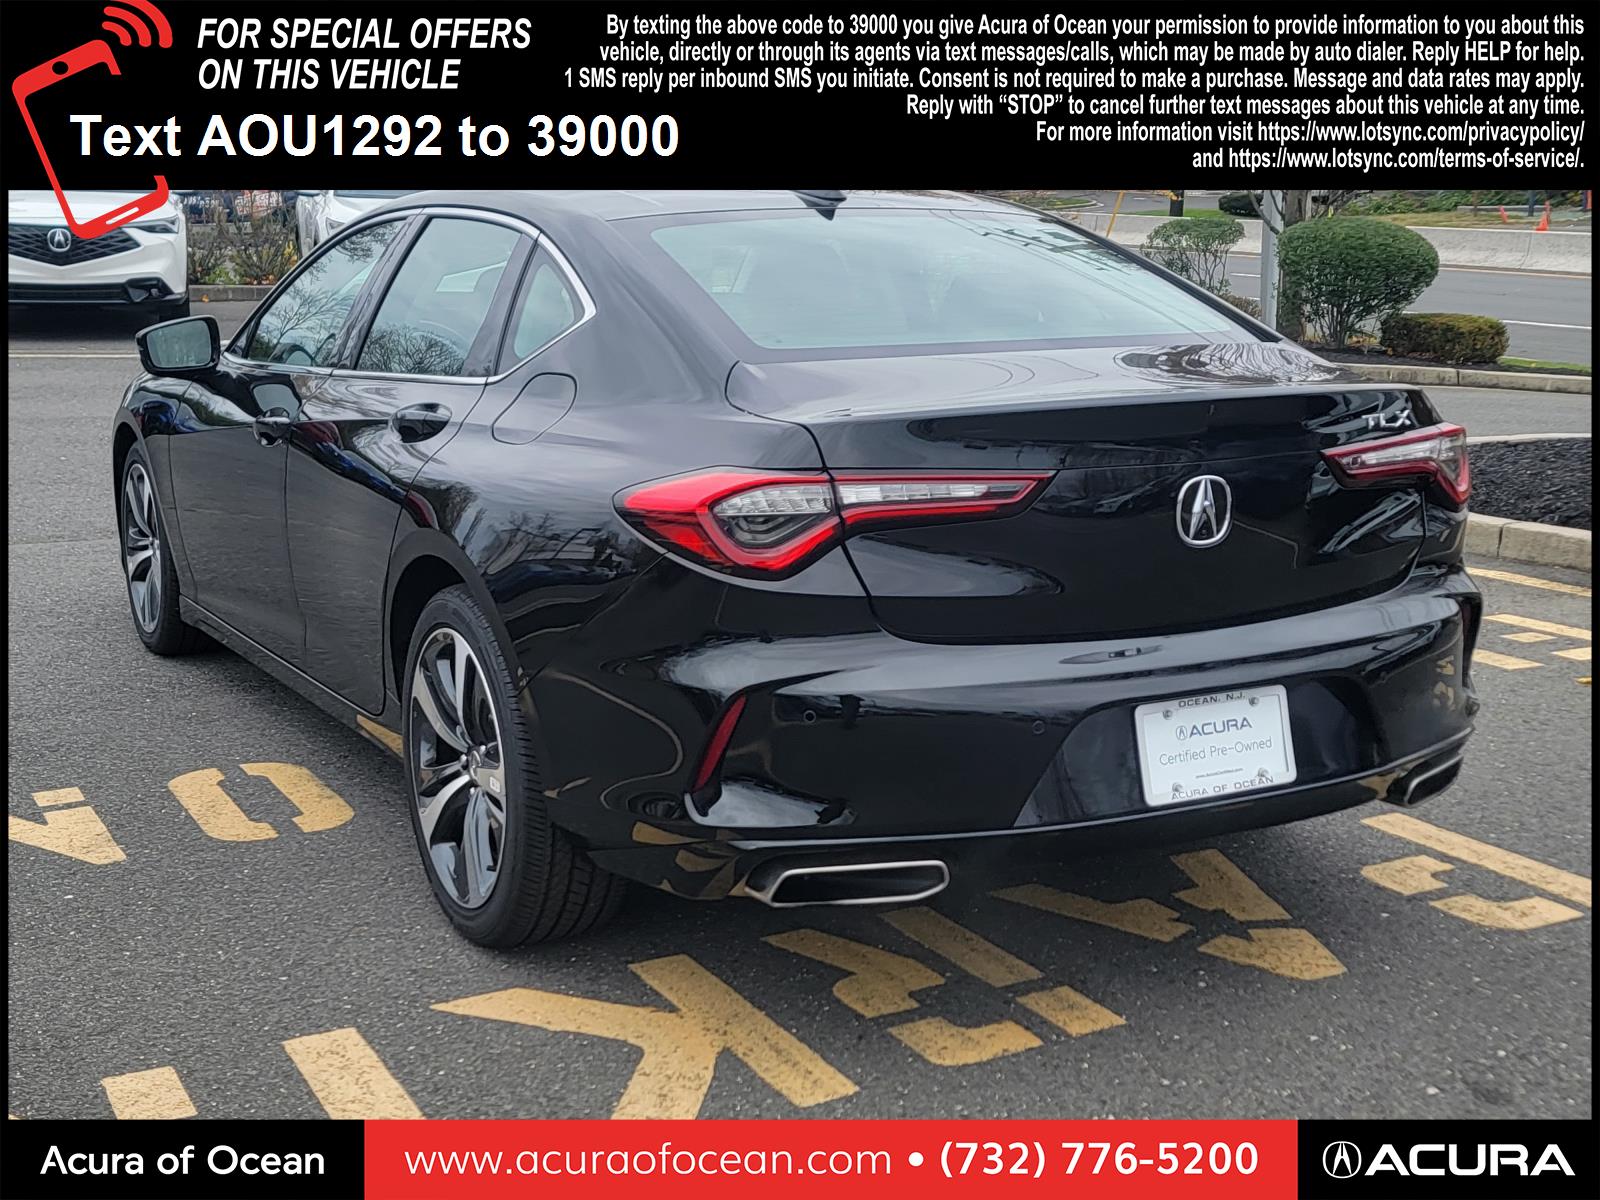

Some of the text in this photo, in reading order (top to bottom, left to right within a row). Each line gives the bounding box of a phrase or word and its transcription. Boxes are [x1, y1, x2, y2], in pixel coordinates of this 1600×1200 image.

[1361, 409, 1411, 430] TLX
[1189, 717, 1252, 738] ACURA
[1159, 738, 1272, 766] Certified Pre-Owned
[1171, 776, 1274, 801] ACURA OF OCEAN
